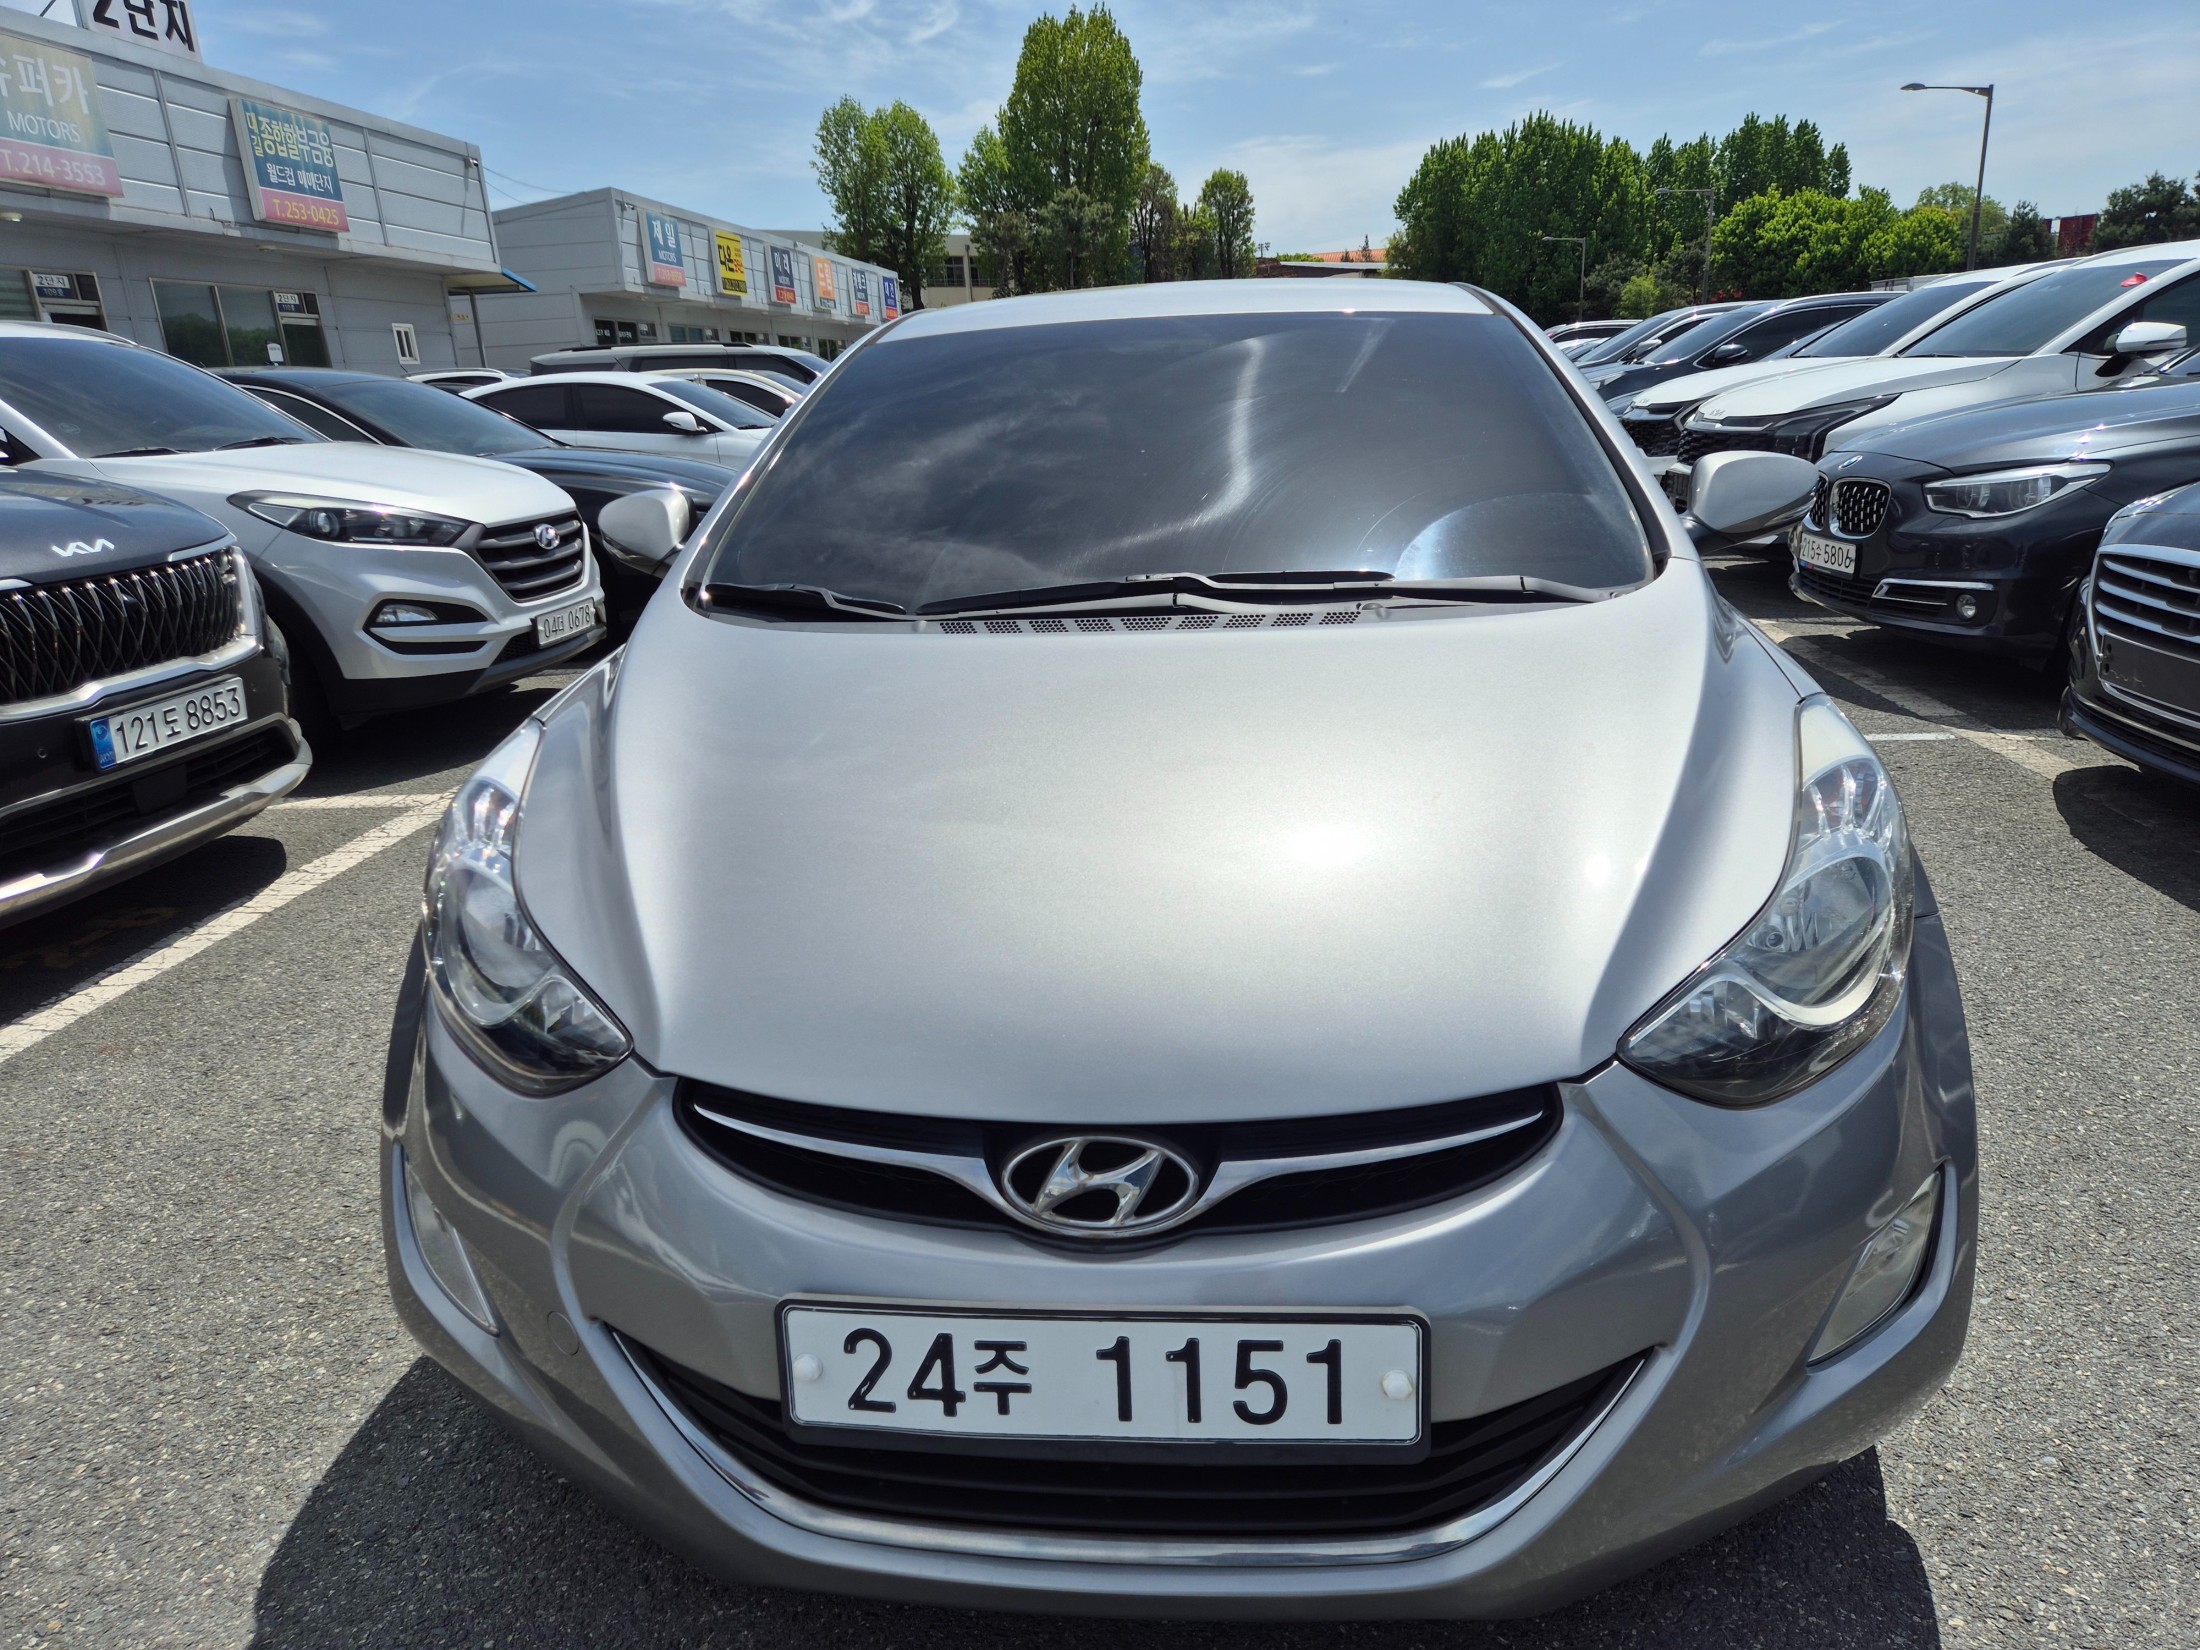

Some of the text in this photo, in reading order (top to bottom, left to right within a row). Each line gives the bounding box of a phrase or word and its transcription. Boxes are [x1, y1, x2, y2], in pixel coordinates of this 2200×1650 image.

[7, 110, 81, 143] MOTORS
[3, 150, 107, 186] T.214-3553
[266, 163, 296, 187] 월드컵
[273, 198, 340, 226] T.253-0425
[652, 219, 677, 249] 제일
[658, 250, 677, 263] MOTORS
[1823, 543, 1852, 569] 5806
[568, 604, 591, 630] 0678
[116, 686, 241, 753] 121도 8853
[843, 1326, 1343, 1426] 24주 1151
